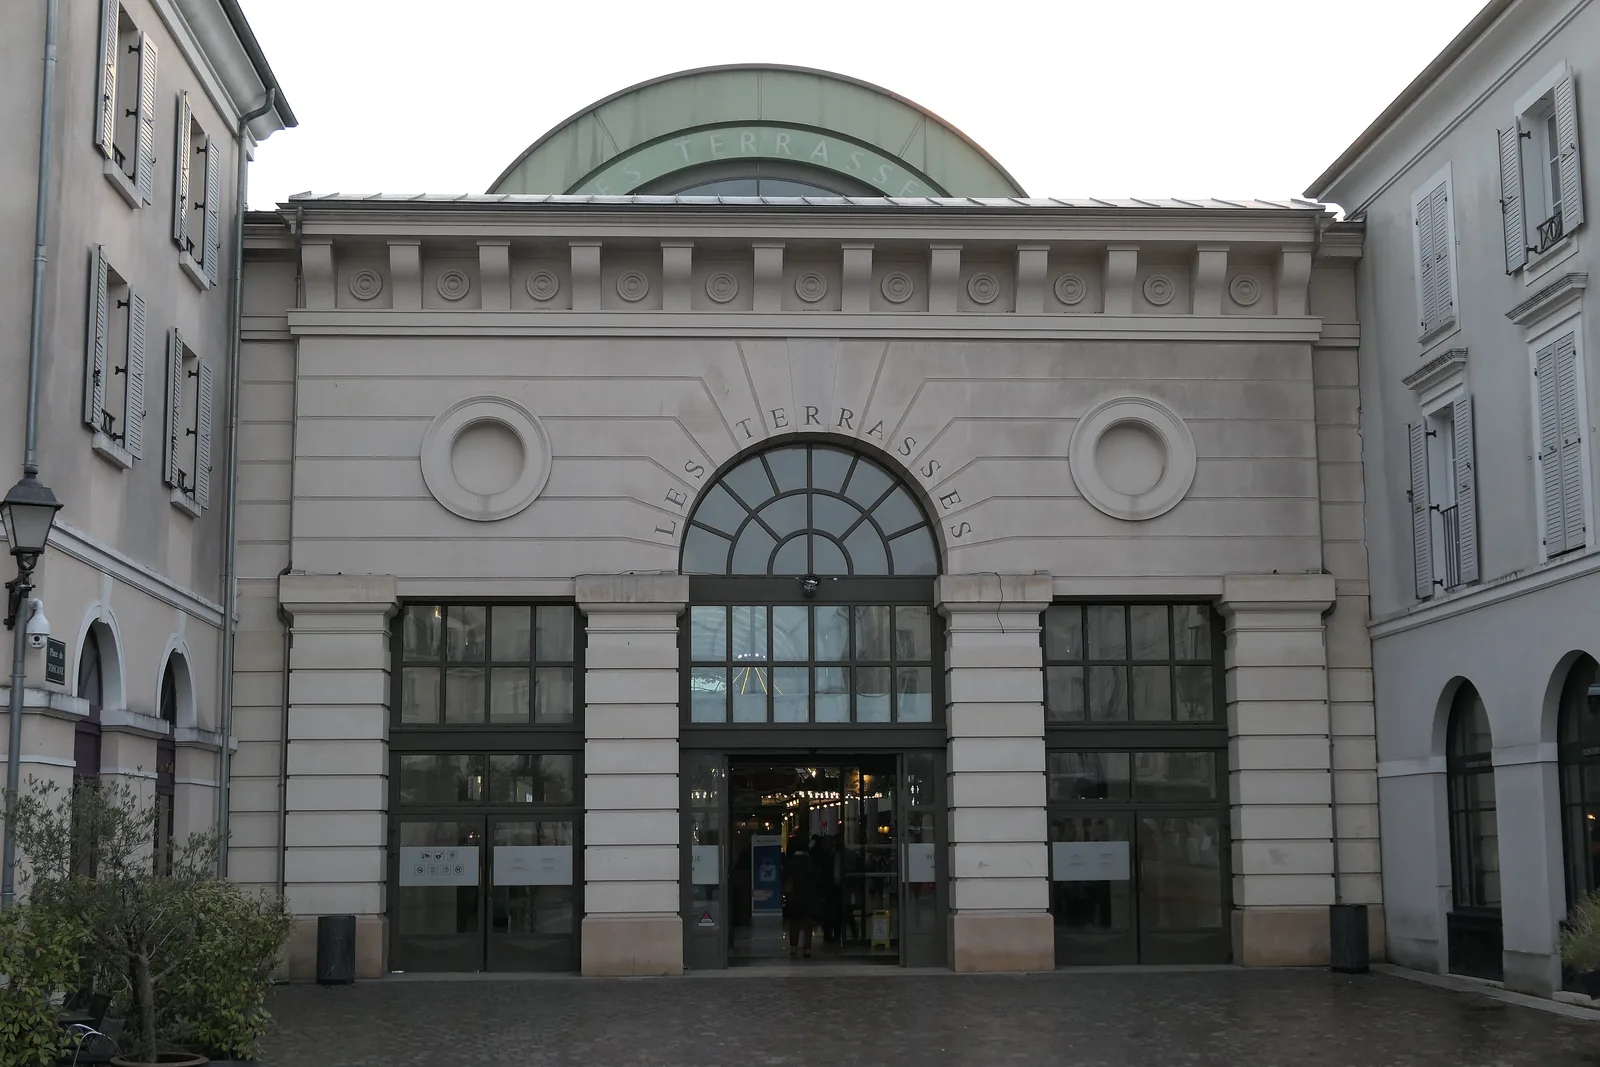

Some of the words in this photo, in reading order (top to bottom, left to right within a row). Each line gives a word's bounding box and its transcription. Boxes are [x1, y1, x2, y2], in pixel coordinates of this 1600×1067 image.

[595, 162, 641, 195] ES
[675, 132, 919, 197] TERRASSE
[654, 459, 705, 538] LES
[736, 405, 973, 540] TERRASSES
[50, 648, 58, 657] Place
